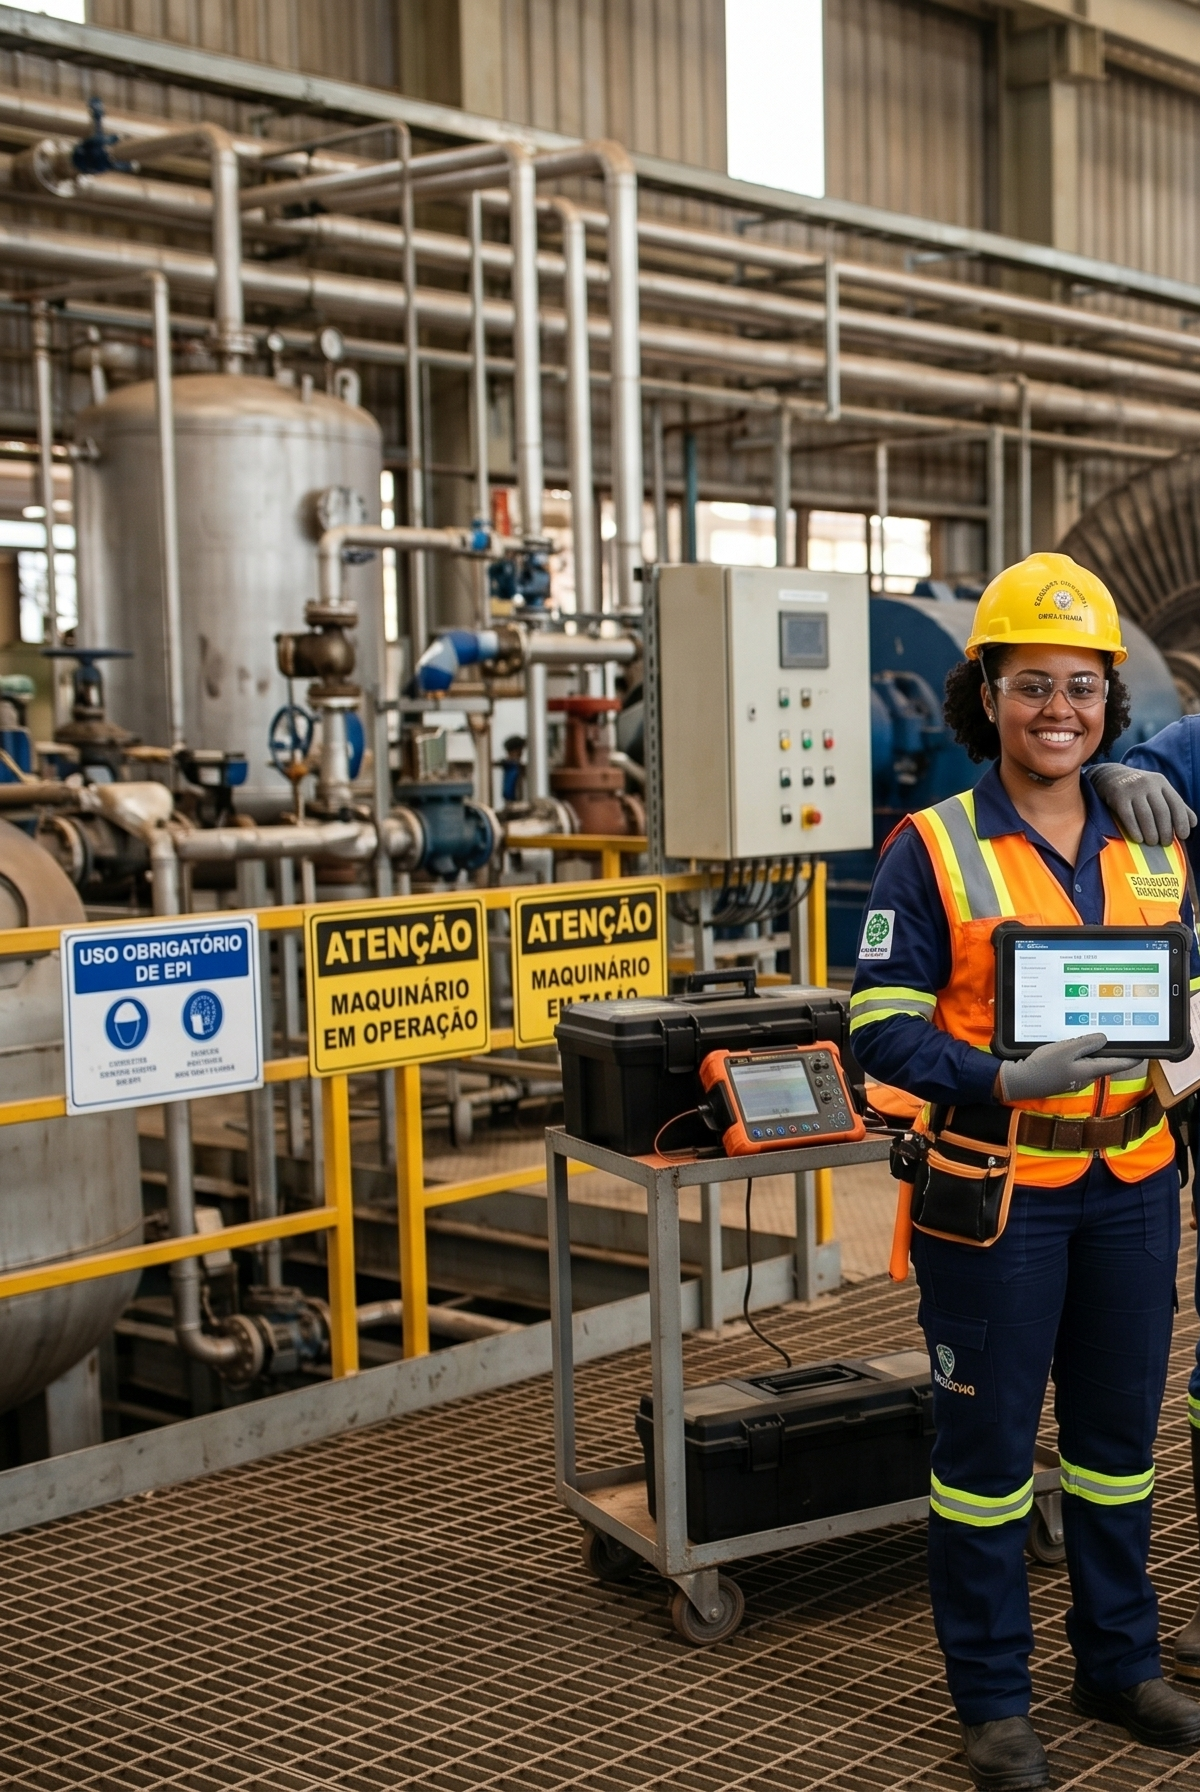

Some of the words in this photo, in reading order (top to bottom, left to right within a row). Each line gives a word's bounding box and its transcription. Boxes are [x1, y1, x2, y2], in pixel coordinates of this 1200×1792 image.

[325, 914, 472, 965] ATENÇÃO
[527, 898, 652, 944] ATENÇÃO
[79, 946, 119, 965] USO
[122, 933, 243, 962] OBRIGATÓRIO
[135, 964, 160, 982] DE
[164, 961, 192, 979] EPI
[532, 955, 650, 990] MAQUINÁRIO
[331, 977, 469, 1016] MAQUINÁRIO
[324, 1026, 356, 1050] EM
[363, 1006, 478, 1040] OPERAÇÃO
